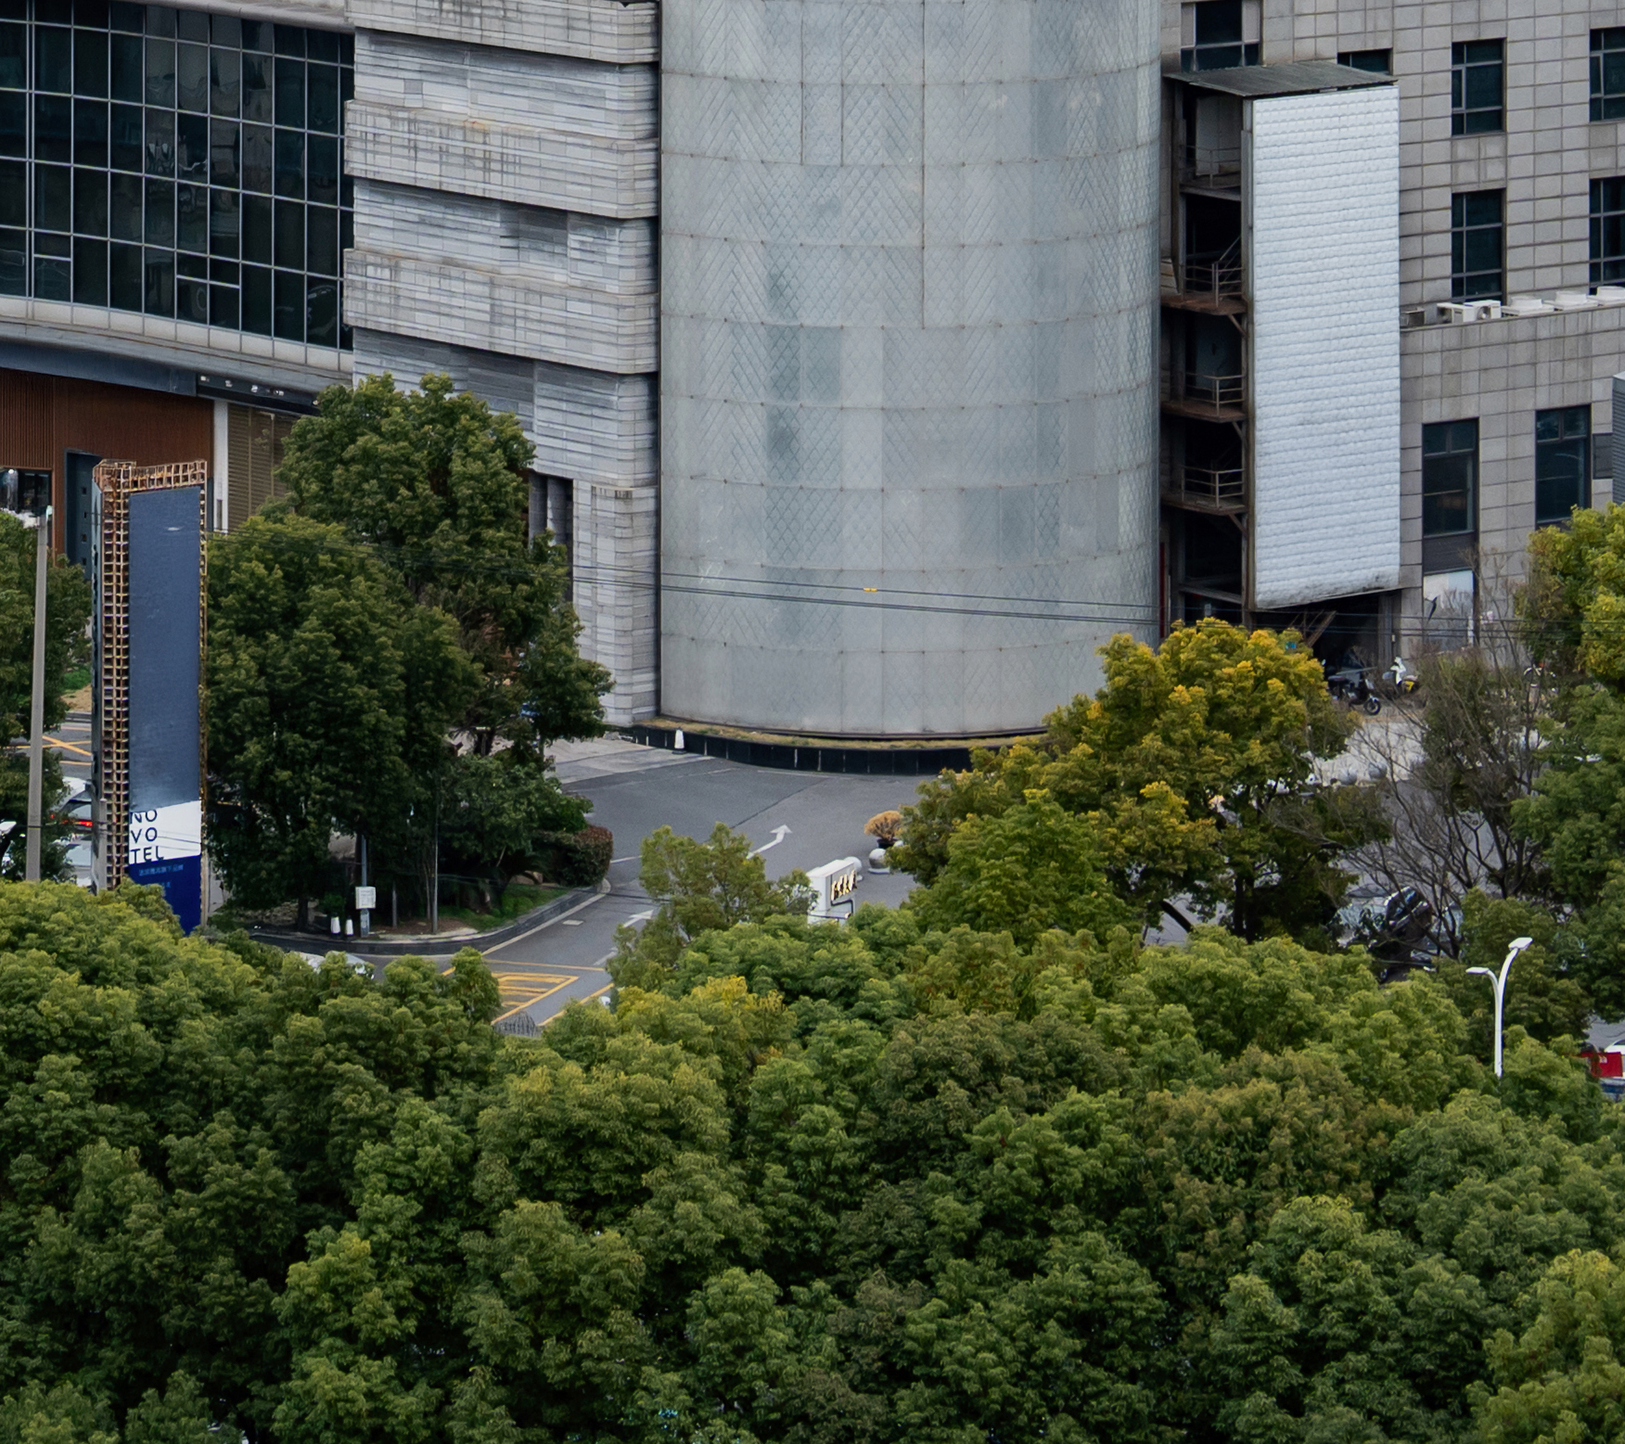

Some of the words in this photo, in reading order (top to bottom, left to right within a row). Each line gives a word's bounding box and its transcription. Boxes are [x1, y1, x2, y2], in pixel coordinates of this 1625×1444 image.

[129, 809, 158, 825] NO
[130, 827, 158, 844] VO
[130, 845, 165, 864] TEL
